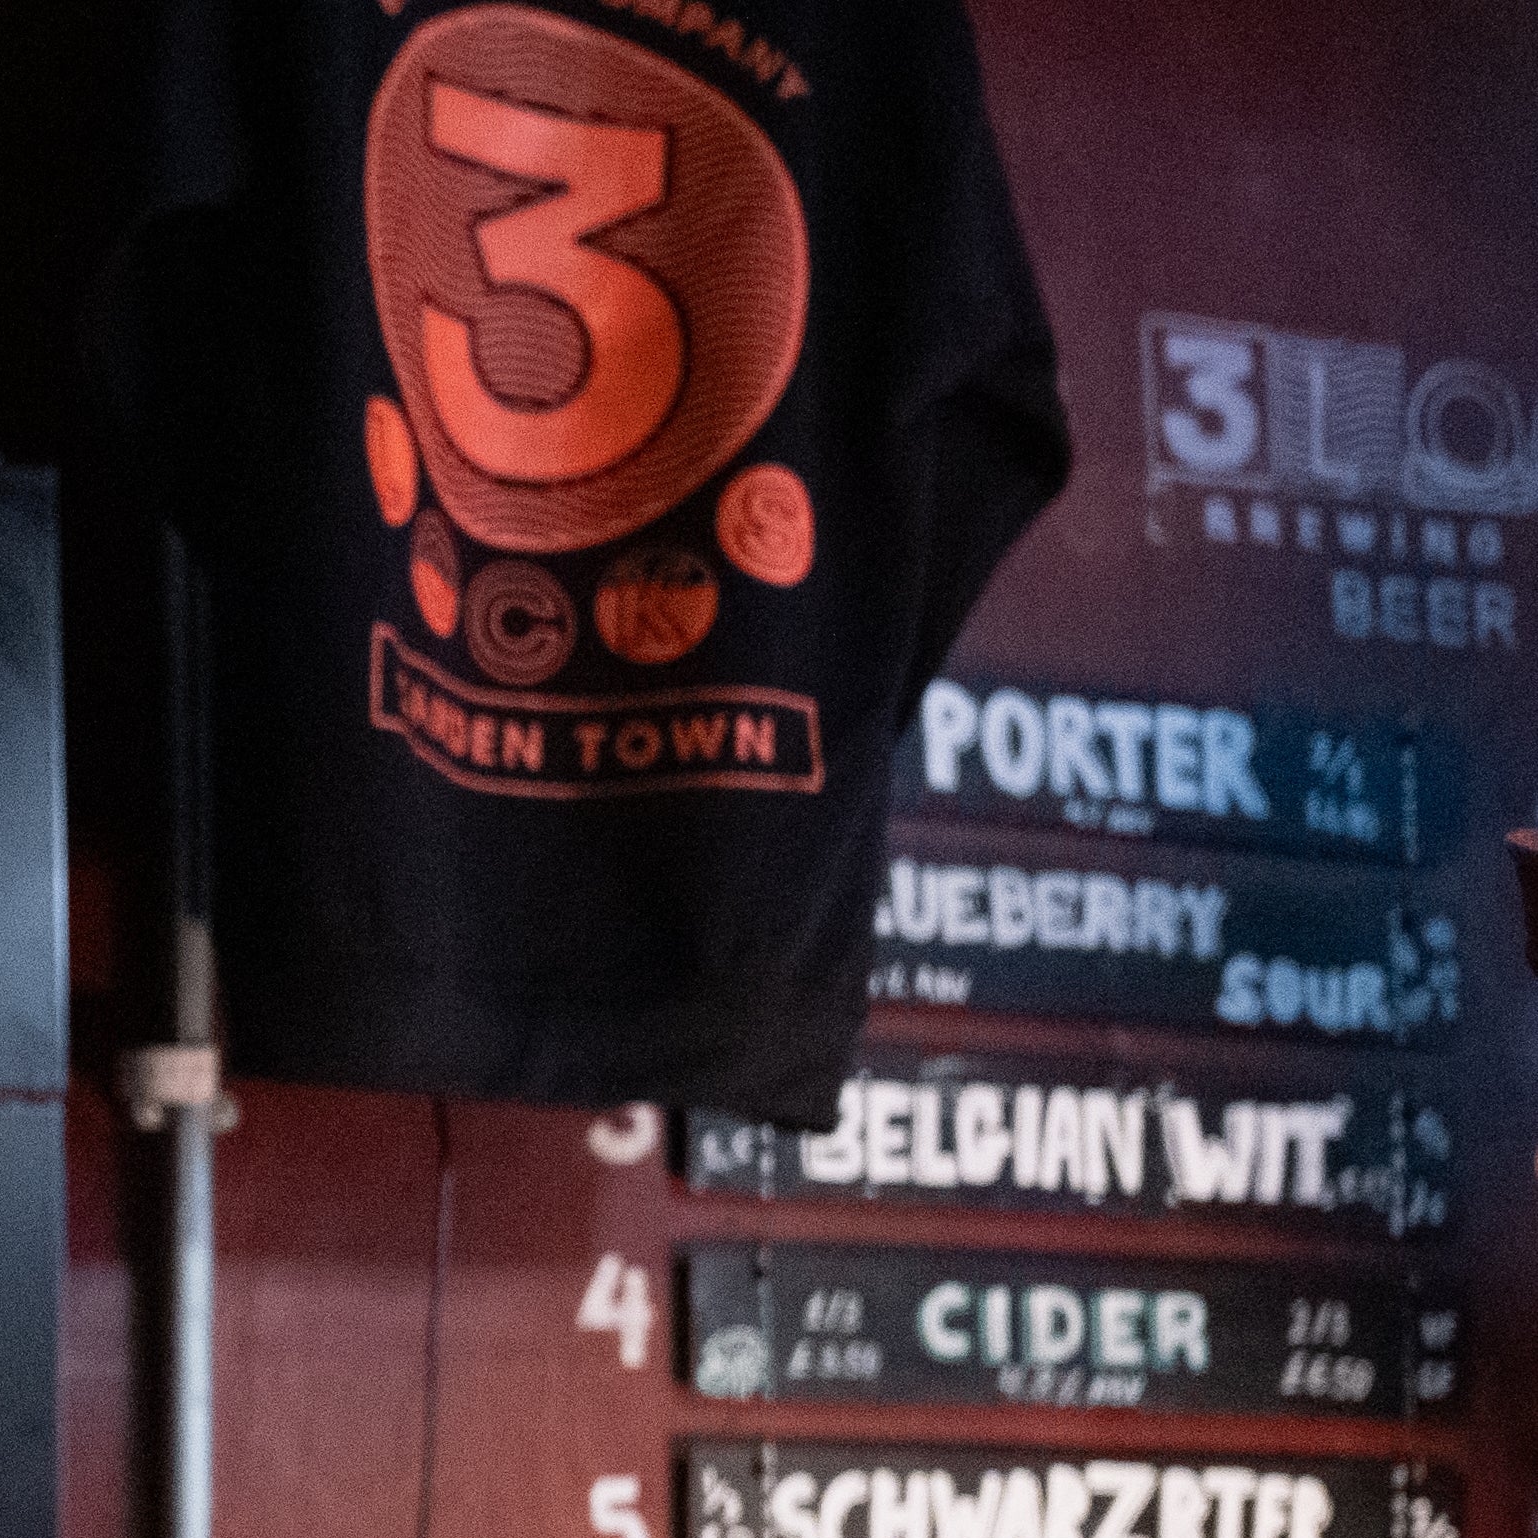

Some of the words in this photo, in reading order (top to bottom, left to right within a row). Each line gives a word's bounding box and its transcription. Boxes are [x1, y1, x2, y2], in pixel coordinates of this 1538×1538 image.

[422, 78, 688, 484] 3
[1331, 569, 1521, 650] BEER
[572, 710, 778, 774] TOWN
[922, 678, 1270, 822] PORTER
[873, 857, 1224, 962] UEBERRY
[1214, 950, 1394, 1034] SOUR
[800, 1076, 1145, 1205] BELGIAN
[576, 1253, 654, 1370] 4
[916, 1278, 1211, 1374] CIDER
